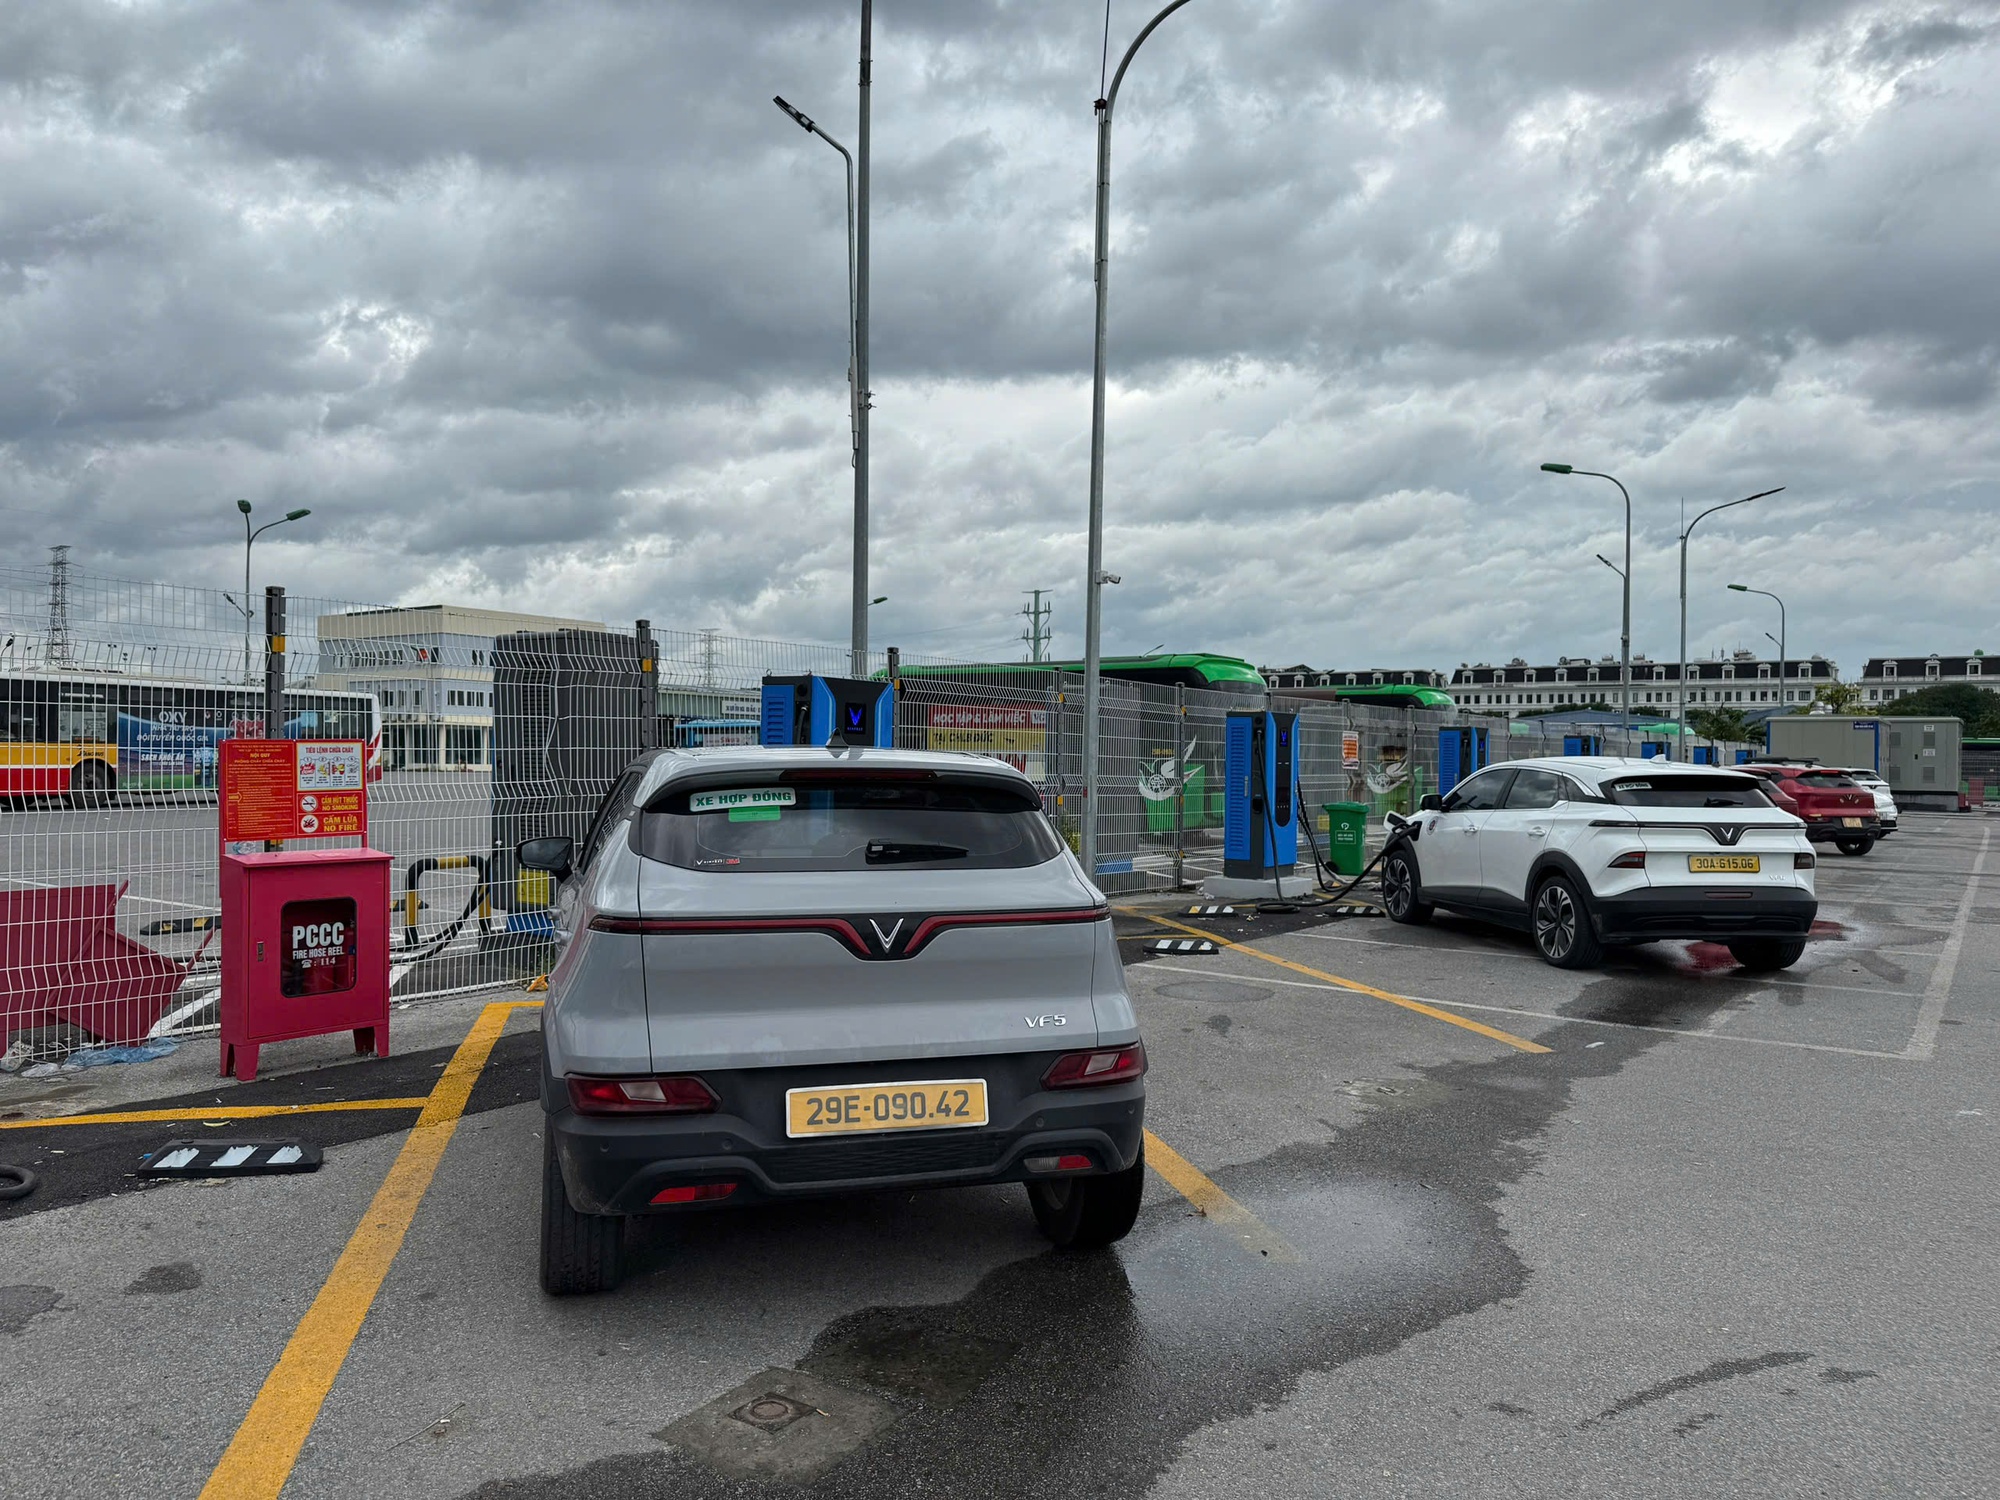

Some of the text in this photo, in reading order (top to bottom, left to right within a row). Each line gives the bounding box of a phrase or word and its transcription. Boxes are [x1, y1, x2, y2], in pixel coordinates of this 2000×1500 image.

[158, 711, 187, 723] OXY
[934, 713, 954, 726] HỌC
[956, 711, 972, 726] TẬP
[982, 711, 1003, 724] LÀM
[1005, 711, 1026, 726] VIỆC
[316, 746, 328, 754] LỆNH
[321, 794, 358, 804] CẤM HÚT THUỐC
[696, 790, 792, 806] XE HỢP ĐỒNG
[324, 814, 357, 824] CẤM LỬA
[1696, 858, 1754, 869] 30A-615.06
[292, 922, 344, 949] PCCC
[292, 946, 344, 960] FIRE HOSE REEL
[320, 957, 336, 966] 114
[1024, 1014, 1068, 1028] VF5
[806, 1090, 970, 1126] 29E-090.42
